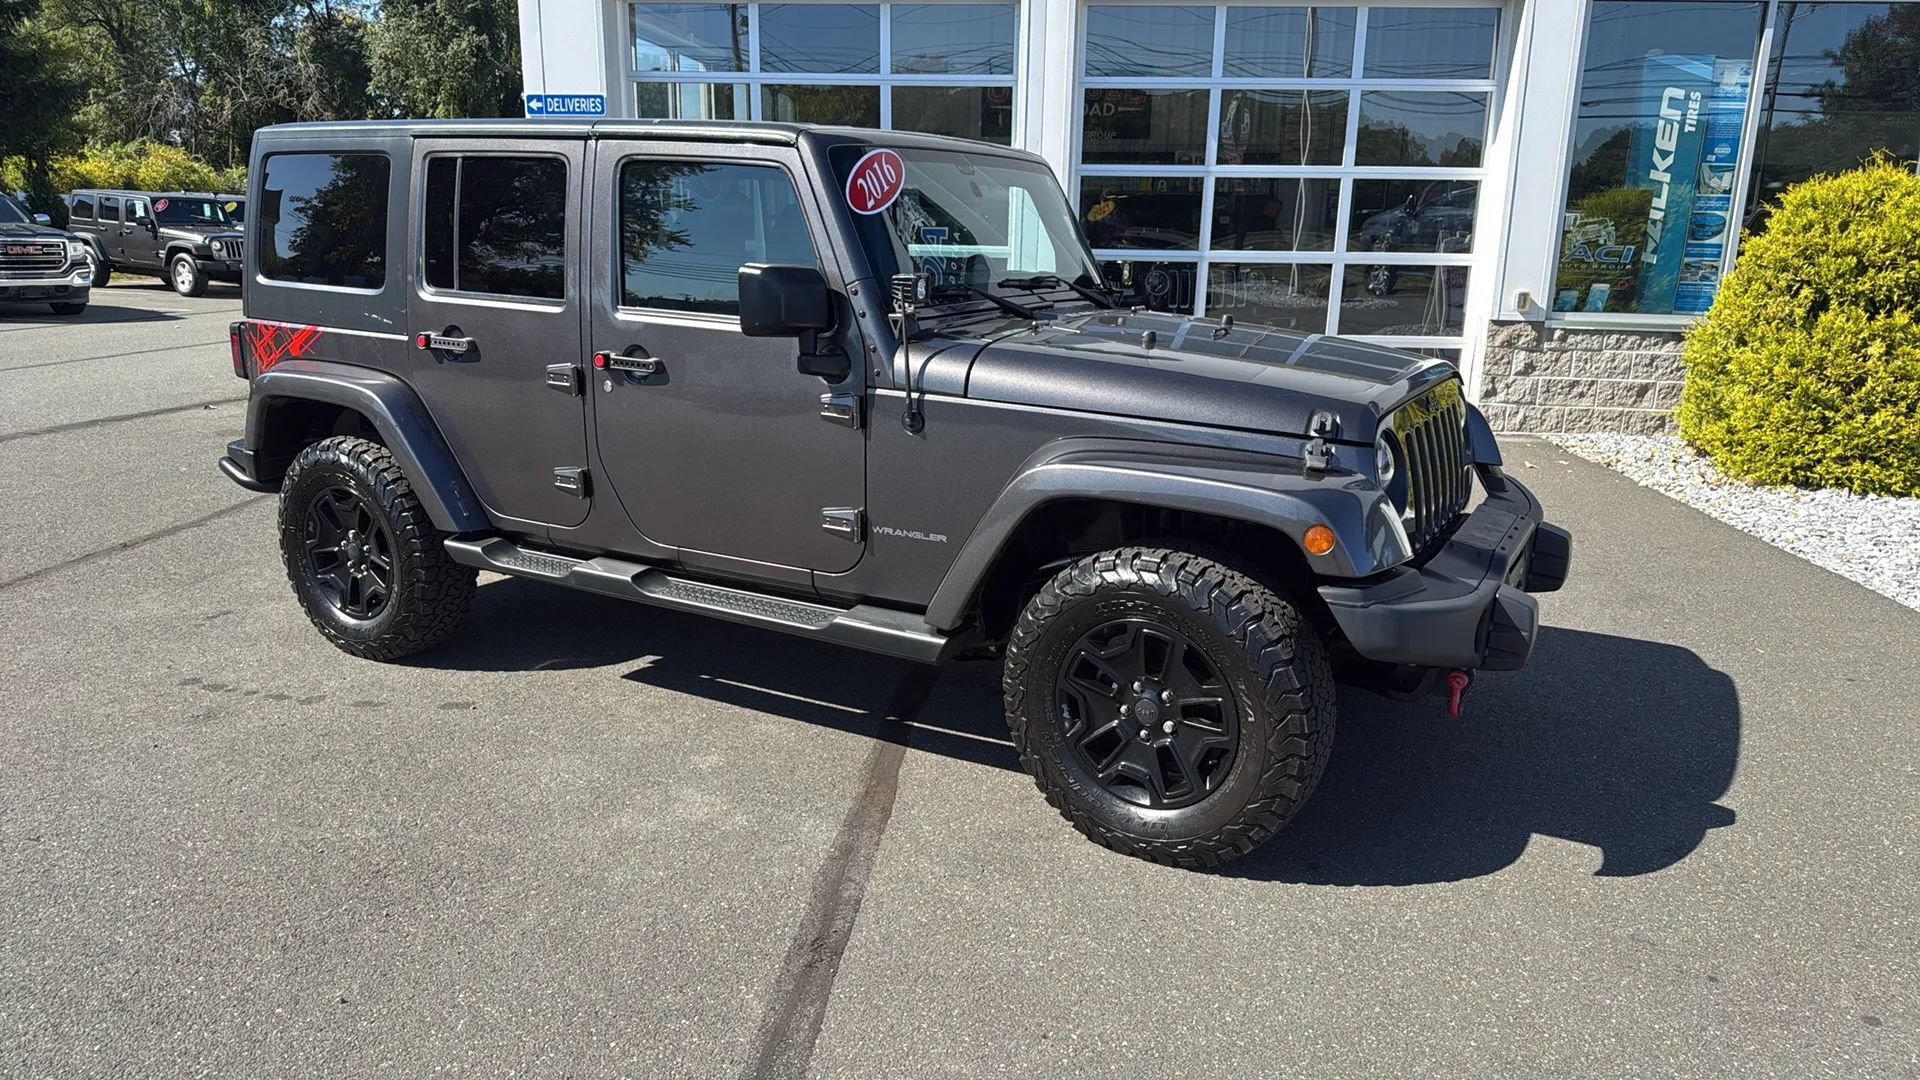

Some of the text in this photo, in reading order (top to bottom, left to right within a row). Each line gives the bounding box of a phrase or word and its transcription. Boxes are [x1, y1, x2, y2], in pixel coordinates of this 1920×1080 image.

[547, 97, 602, 112] DELIVERIES
[1684, 91, 1702, 133] TIRES
[857, 153, 896, 210] 2016
[7, 245, 43, 255] GMC
[1561, 244, 1635, 263] ACI
[872, 526, 948, 543] WRANGLER
